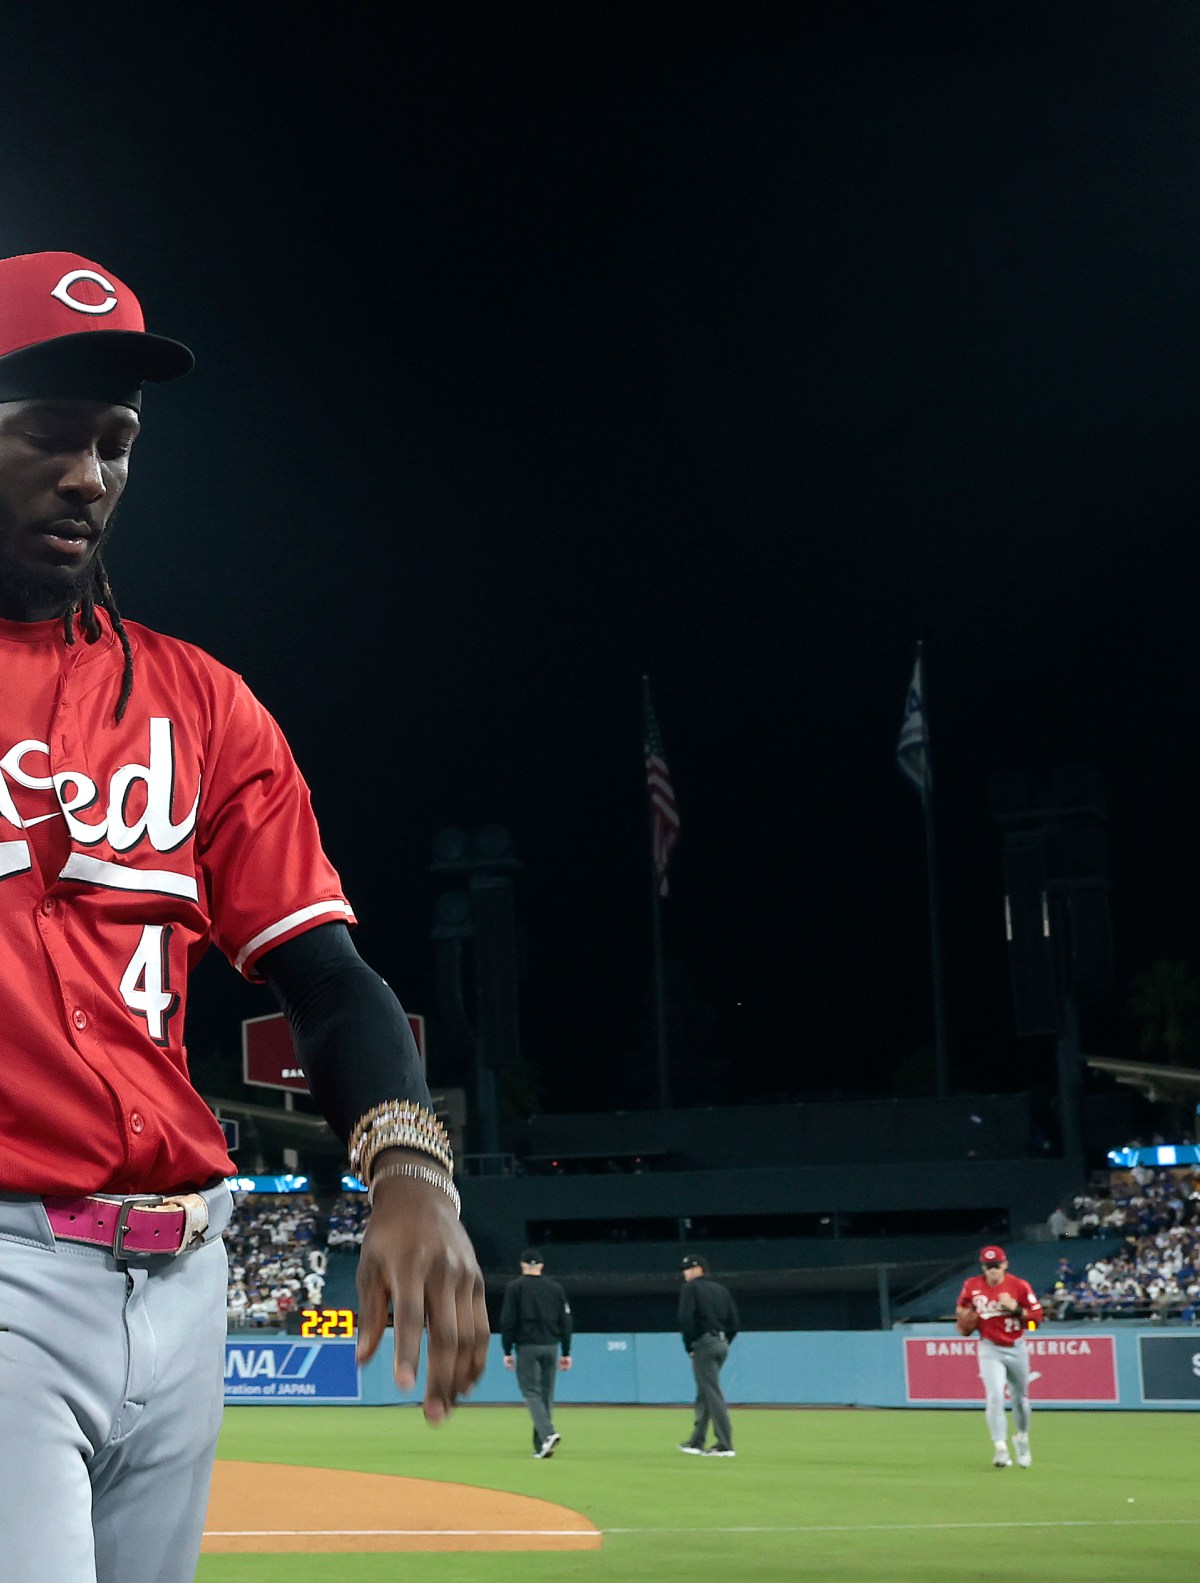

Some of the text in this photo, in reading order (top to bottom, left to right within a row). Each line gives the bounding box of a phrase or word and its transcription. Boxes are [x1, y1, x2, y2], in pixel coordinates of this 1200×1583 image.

[51, 269, 118, 316] C
[119, 924, 179, 1046] 4
[301, 1309, 355, 1338] 2:23
[926, 1340, 1092, 1356] BANK MERICA
[223, 1350, 276, 1378] NA
[263, 1383, 277, 1395] of
[277, 1383, 317, 1395] JAPAN
